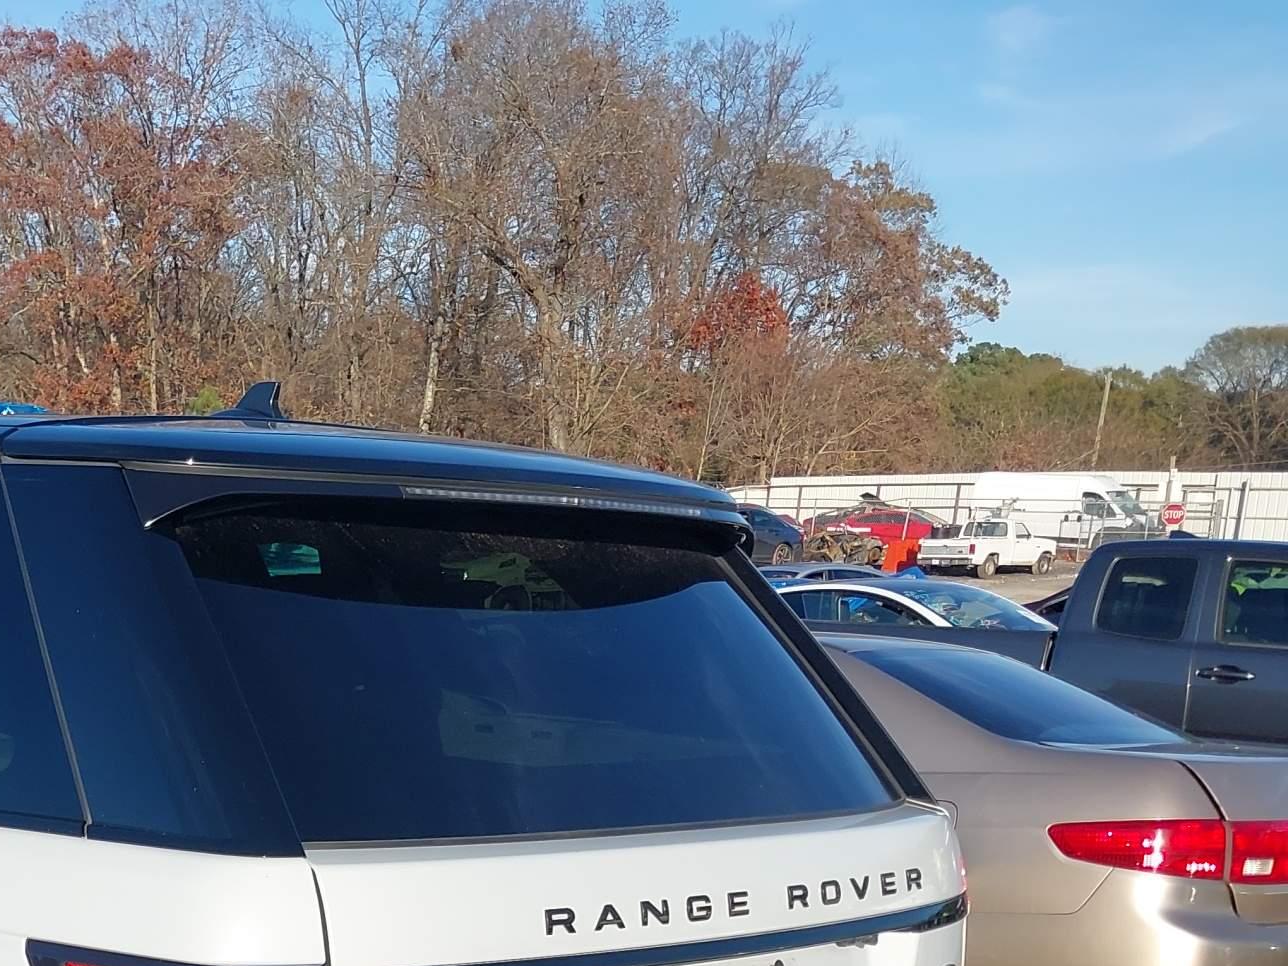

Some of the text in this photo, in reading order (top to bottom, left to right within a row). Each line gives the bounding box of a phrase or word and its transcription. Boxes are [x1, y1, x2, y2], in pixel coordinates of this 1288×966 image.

[1163, 510, 1184, 519] STOP
[543, 867, 924, 936] RANGE ROVER
